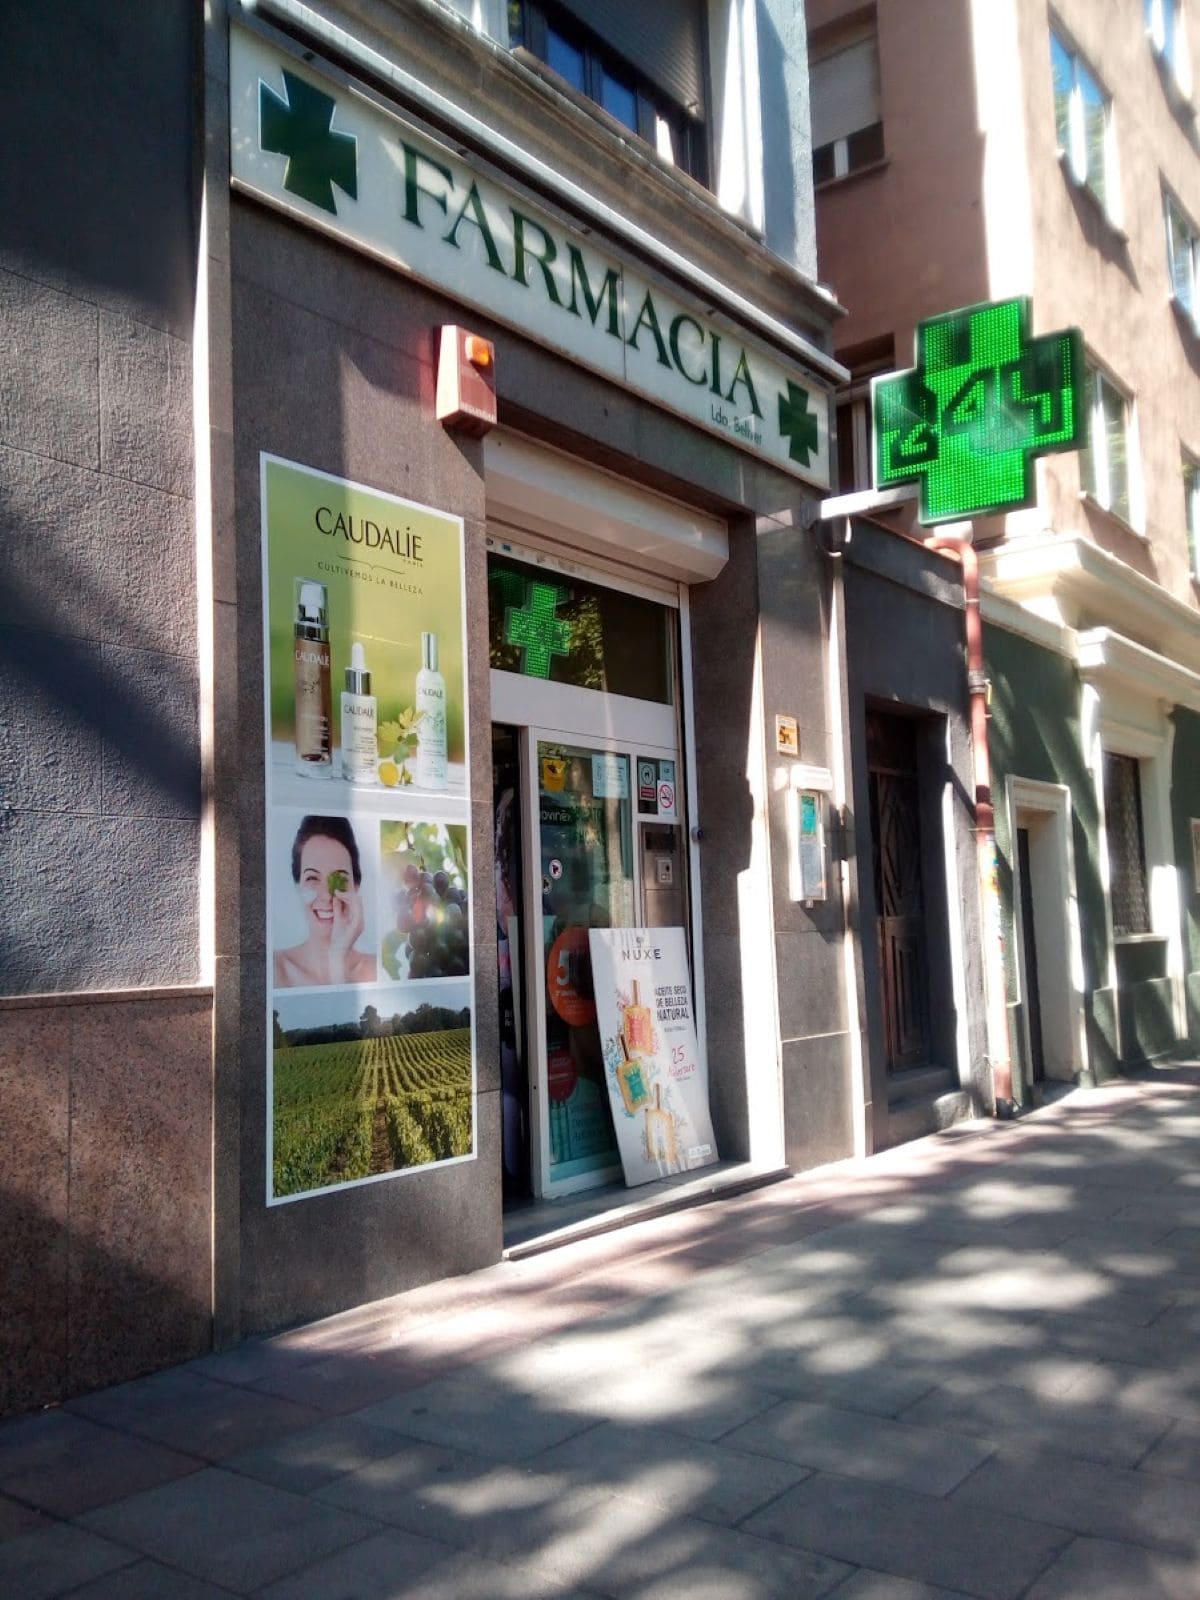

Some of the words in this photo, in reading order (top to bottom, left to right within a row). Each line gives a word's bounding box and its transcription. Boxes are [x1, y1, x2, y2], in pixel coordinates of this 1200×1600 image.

[399, 139, 767, 420] FARMACIA
[315, 507, 424, 562] CAUDALIE
[317, 561, 373, 582] CULTIVEMOS
[376, 576, 386, 585] LA
[389, 580, 424, 595] BELLEZA
[622, 948, 662, 961] NUXE
[656, 1007, 690, 1021] NATURAL
